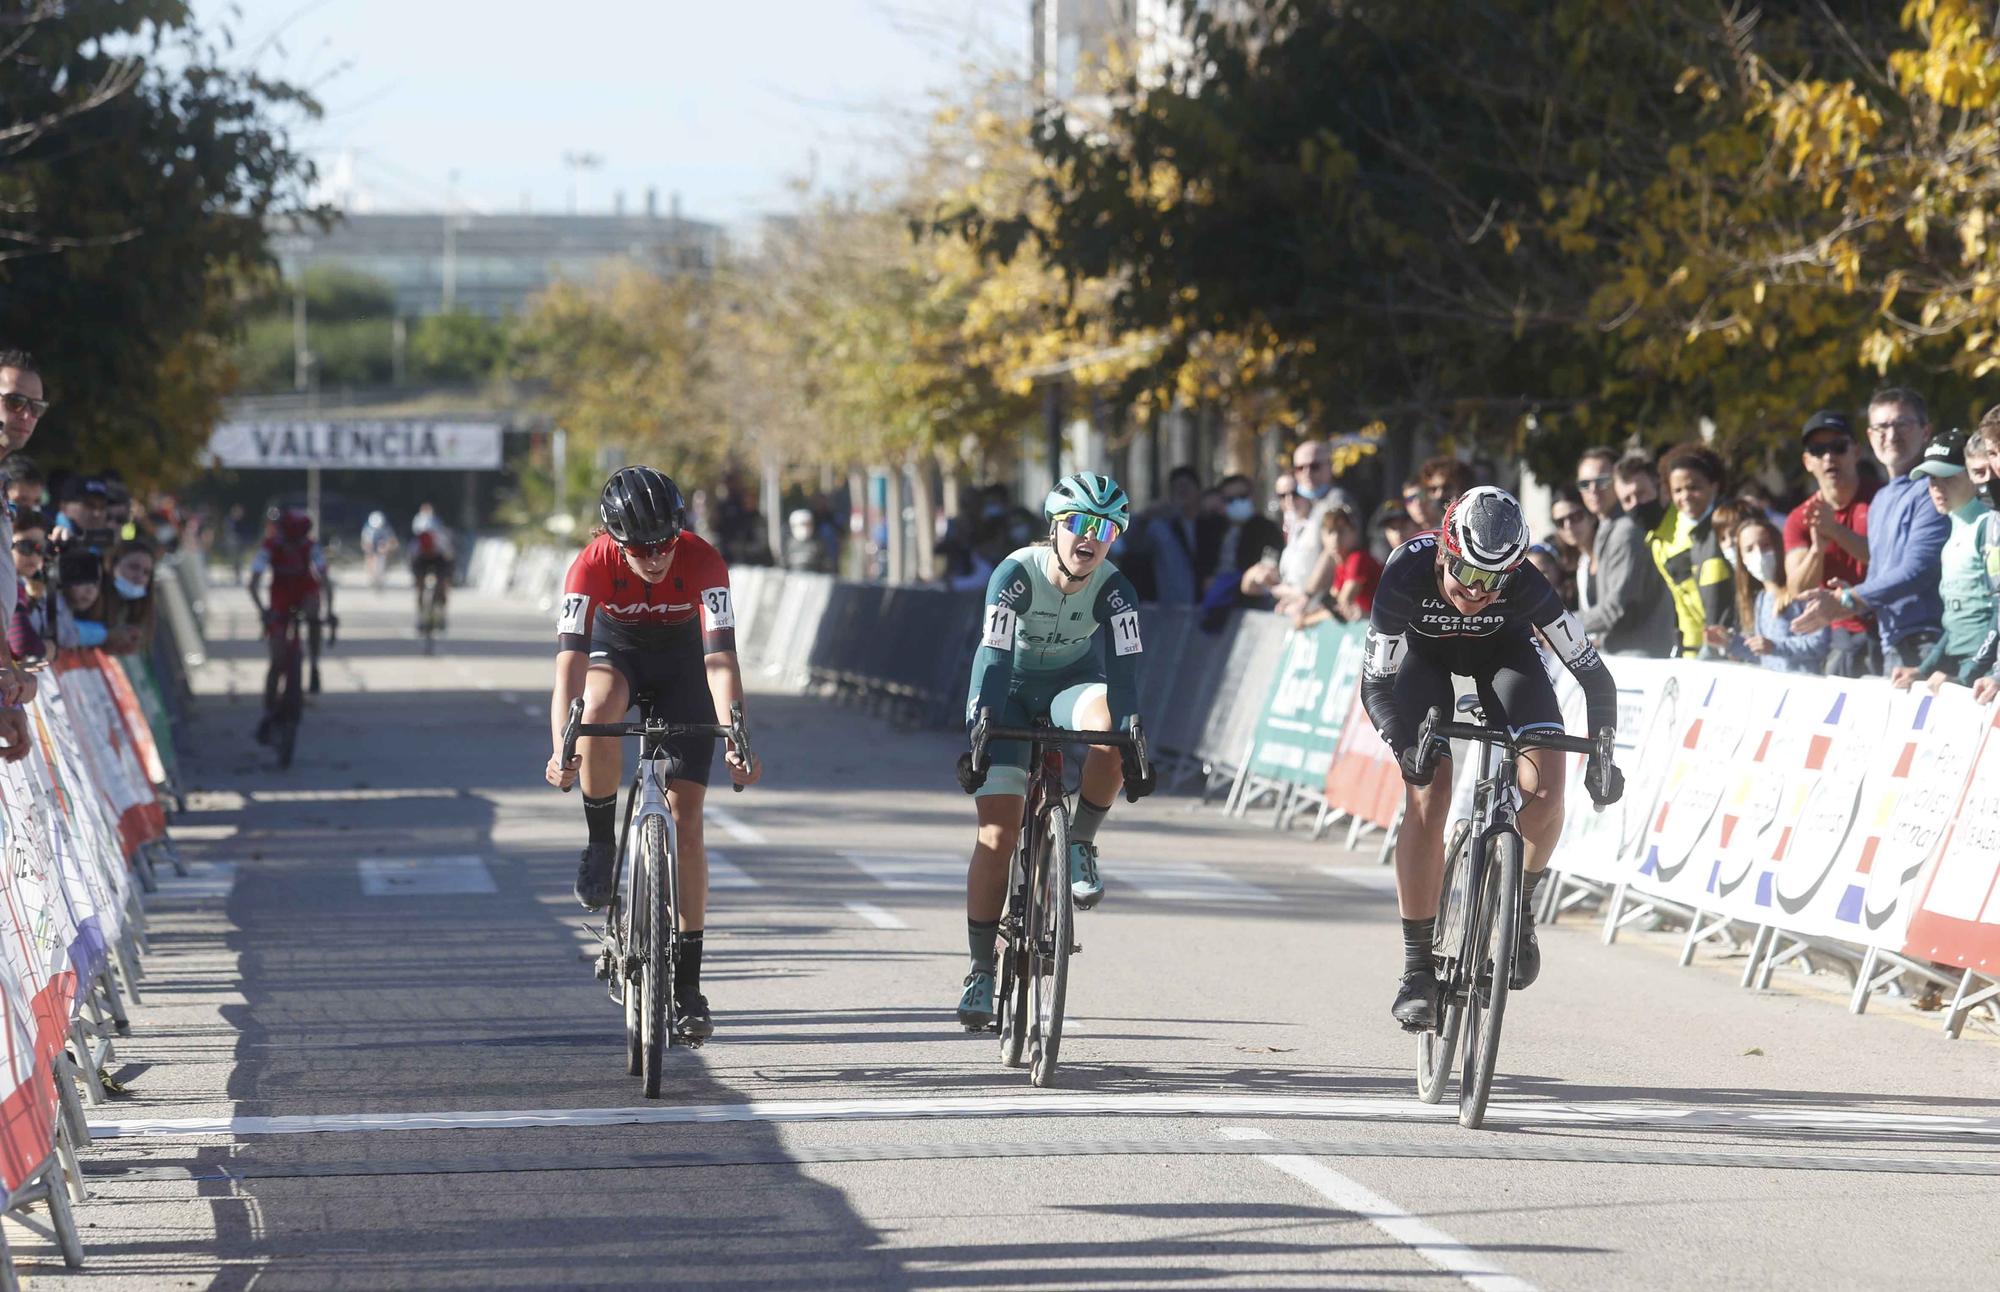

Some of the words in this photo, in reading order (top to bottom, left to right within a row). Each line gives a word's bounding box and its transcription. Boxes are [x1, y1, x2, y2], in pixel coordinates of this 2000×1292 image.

[251, 427, 438, 458] VALENCIA
[708, 591, 728, 615] 37
[998, 579, 1026, 609] eika
[1106, 589, 1134, 614] tei
[1422, 598, 1446, 609] Liv
[563, 597, 583, 619] 37
[1422, 614, 1505, 624] SZCZEPAN
[990, 610, 1010, 636] 11
[1119, 616, 1139, 641] 11
[1441, 623, 1482, 632] bike
[1556, 620, 1574, 642] 7
[1388, 639, 1400, 660] 7
